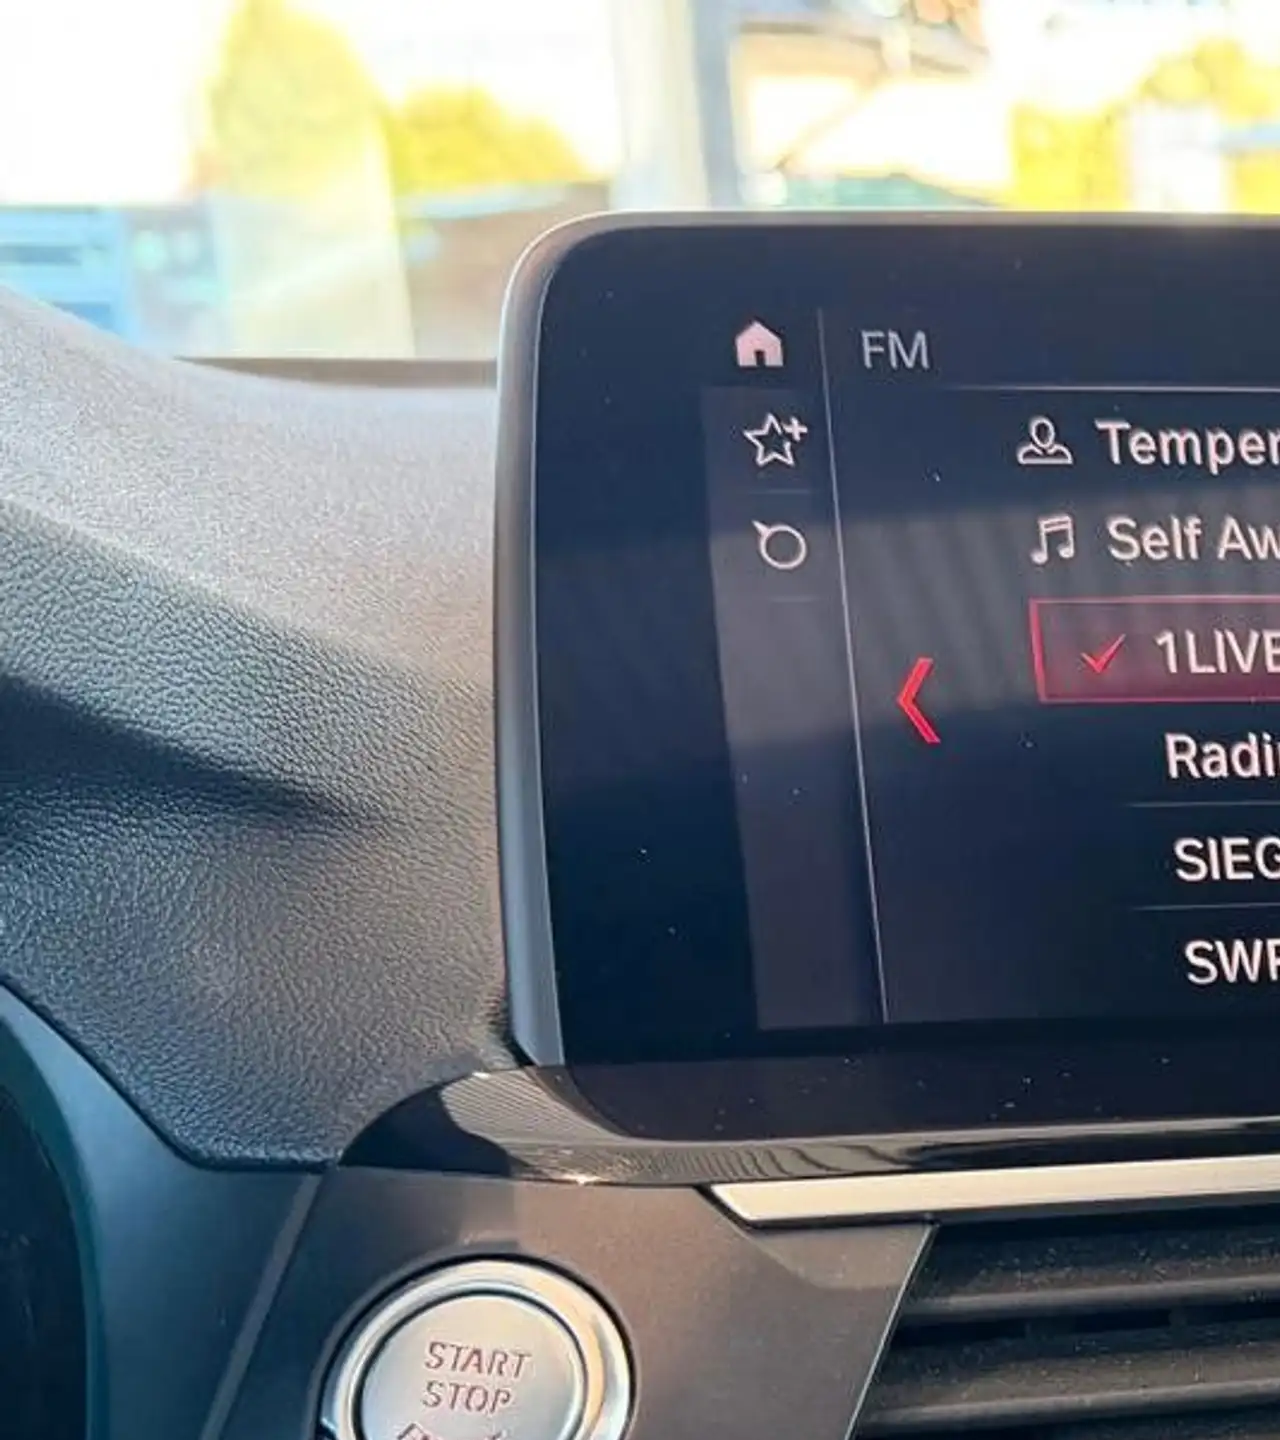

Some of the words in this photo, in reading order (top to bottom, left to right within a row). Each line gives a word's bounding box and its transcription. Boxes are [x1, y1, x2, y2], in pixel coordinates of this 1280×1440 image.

[862, 332, 930, 369] FM
[1108, 516, 1201, 561] Self
[425, 1341, 531, 1379] START
[422, 1380, 511, 1414] STOP
